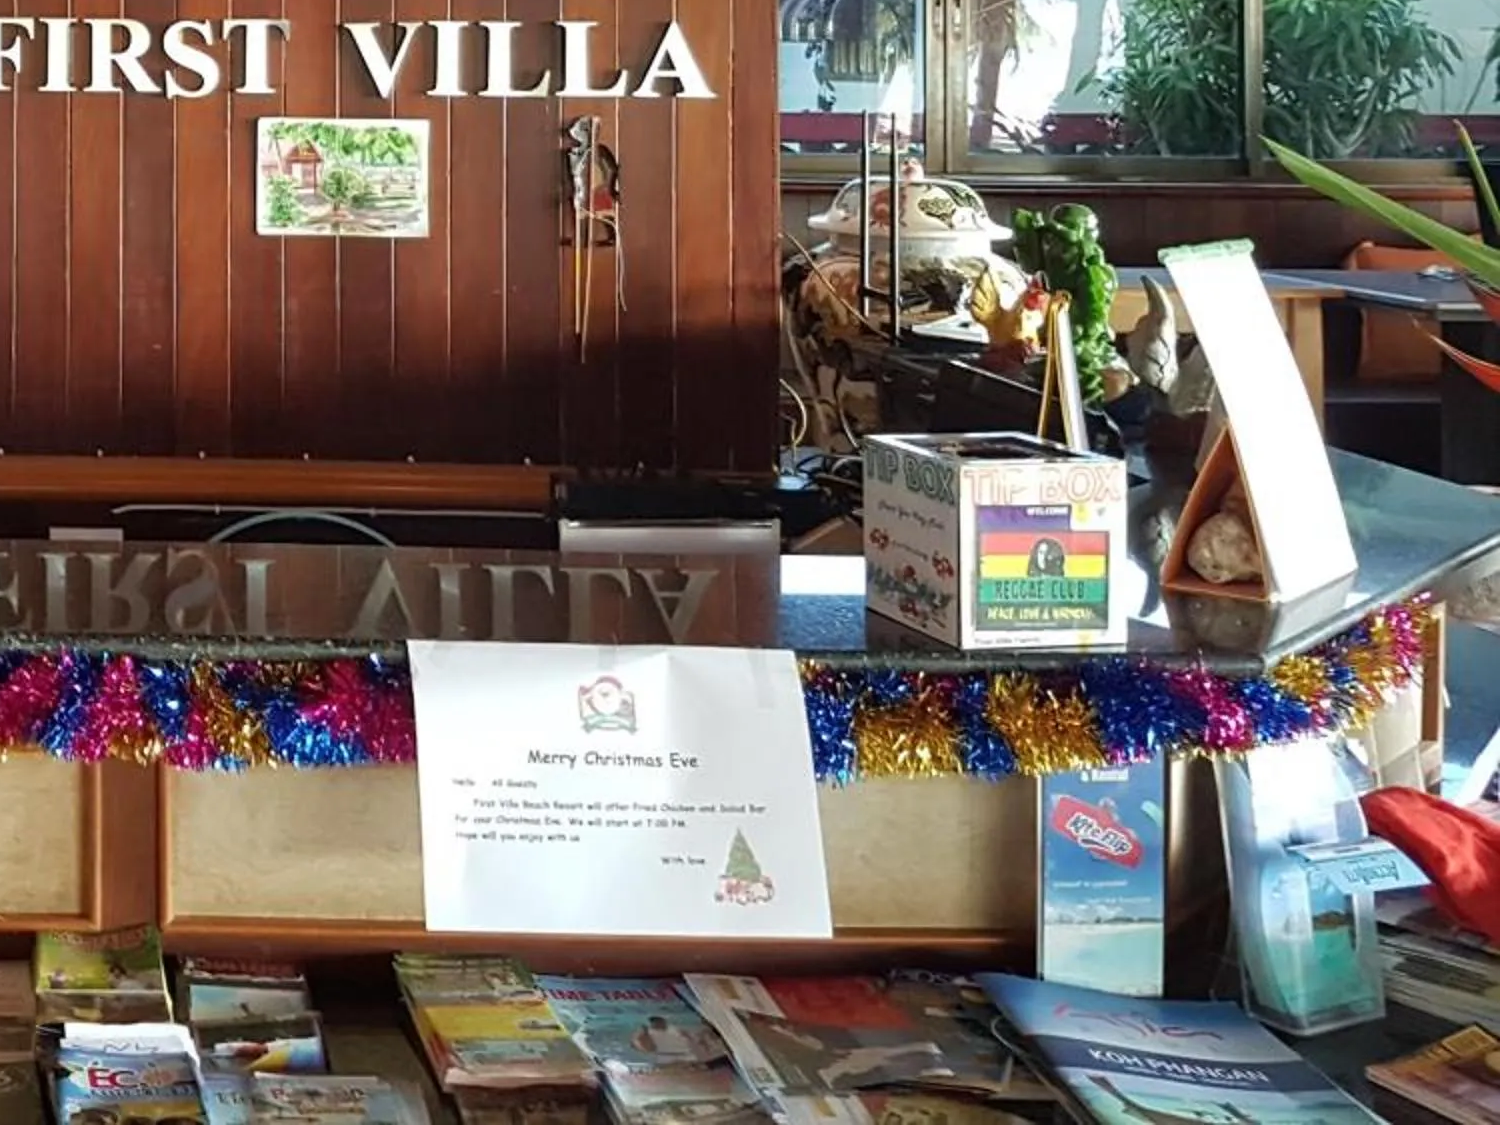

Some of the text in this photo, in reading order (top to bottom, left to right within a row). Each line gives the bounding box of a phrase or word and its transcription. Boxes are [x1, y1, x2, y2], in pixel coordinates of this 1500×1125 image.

[342, 19, 717, 101] VILLA
[866, 446, 956, 506] TIP BOX
[964, 466, 1121, 505] TIP BOX
[994, 580, 1086, 601] REGGAE CLUB
[527, 750, 700, 770] Merry Christmas Eve
[1088, 1047, 1143, 1068] KOH
[1147, 1057, 1270, 1083] PHANGAN
